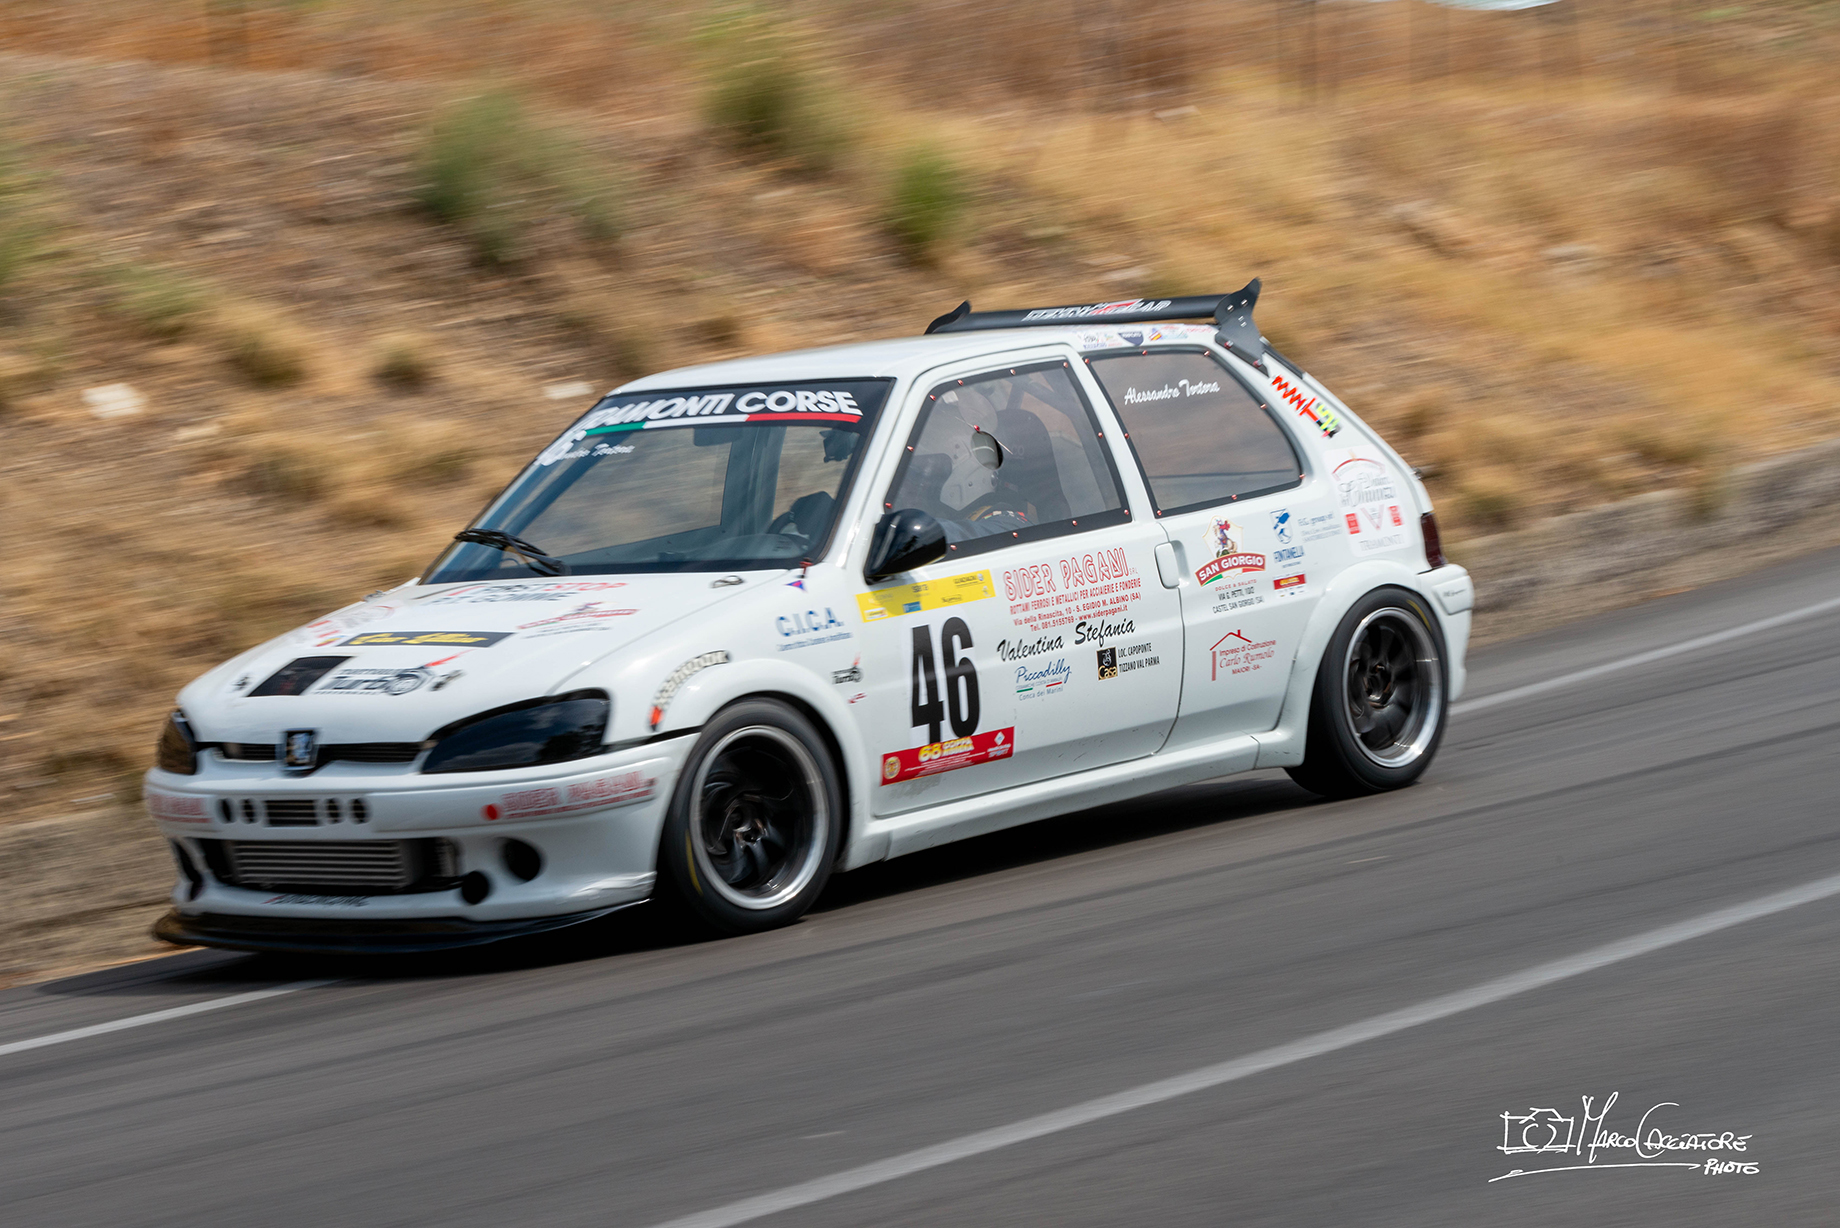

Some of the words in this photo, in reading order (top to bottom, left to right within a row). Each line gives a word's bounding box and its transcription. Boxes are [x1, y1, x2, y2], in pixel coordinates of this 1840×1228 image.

[735, 390, 863, 416] CORSE
[1124, 386, 1180, 405] Alessandro
[1003, 563, 1057, 602] SIDER
[1059, 547, 1129, 589] PAGANI
[1199, 562, 1220, 581] SAN
[1221, 555, 1264, 569] GIORGIO
[1031, 598, 1050, 611] FERROSI
[1055, 592, 1079, 605] METALLICI
[1080, 589, 1089, 600] PER
[1119, 577, 1141, 591] FONDERIE
[1215, 584, 1231, 592] DOLCE
[1013, 618, 1023, 627] Via
[1024, 615, 1037, 624] della
[1083, 600, 1101, 611] EGIDIO
[1109, 594, 1129, 604] ALBINO
[1130, 592, 1141, 602] (SA)
[1030, 624, 1041, 632] Tel.
[1078, 605, 1128, 621] www.siderpagani.it
[1212, 604, 1229, 614] CASTEL
[1229, 602, 1238, 610] SAN
[776, 608, 844, 637] C.I.C.A.
[997, 635, 1064, 662] Valentina
[1075, 618, 1136, 647] Stefania
[1014, 658, 1072, 684] Piccadilly
[1119, 661, 1136, 673] TIZZANO
[1136, 659, 1144, 669] VAL
[1145, 656, 1160, 668] PARMA
[911, 617, 980, 745] 46
